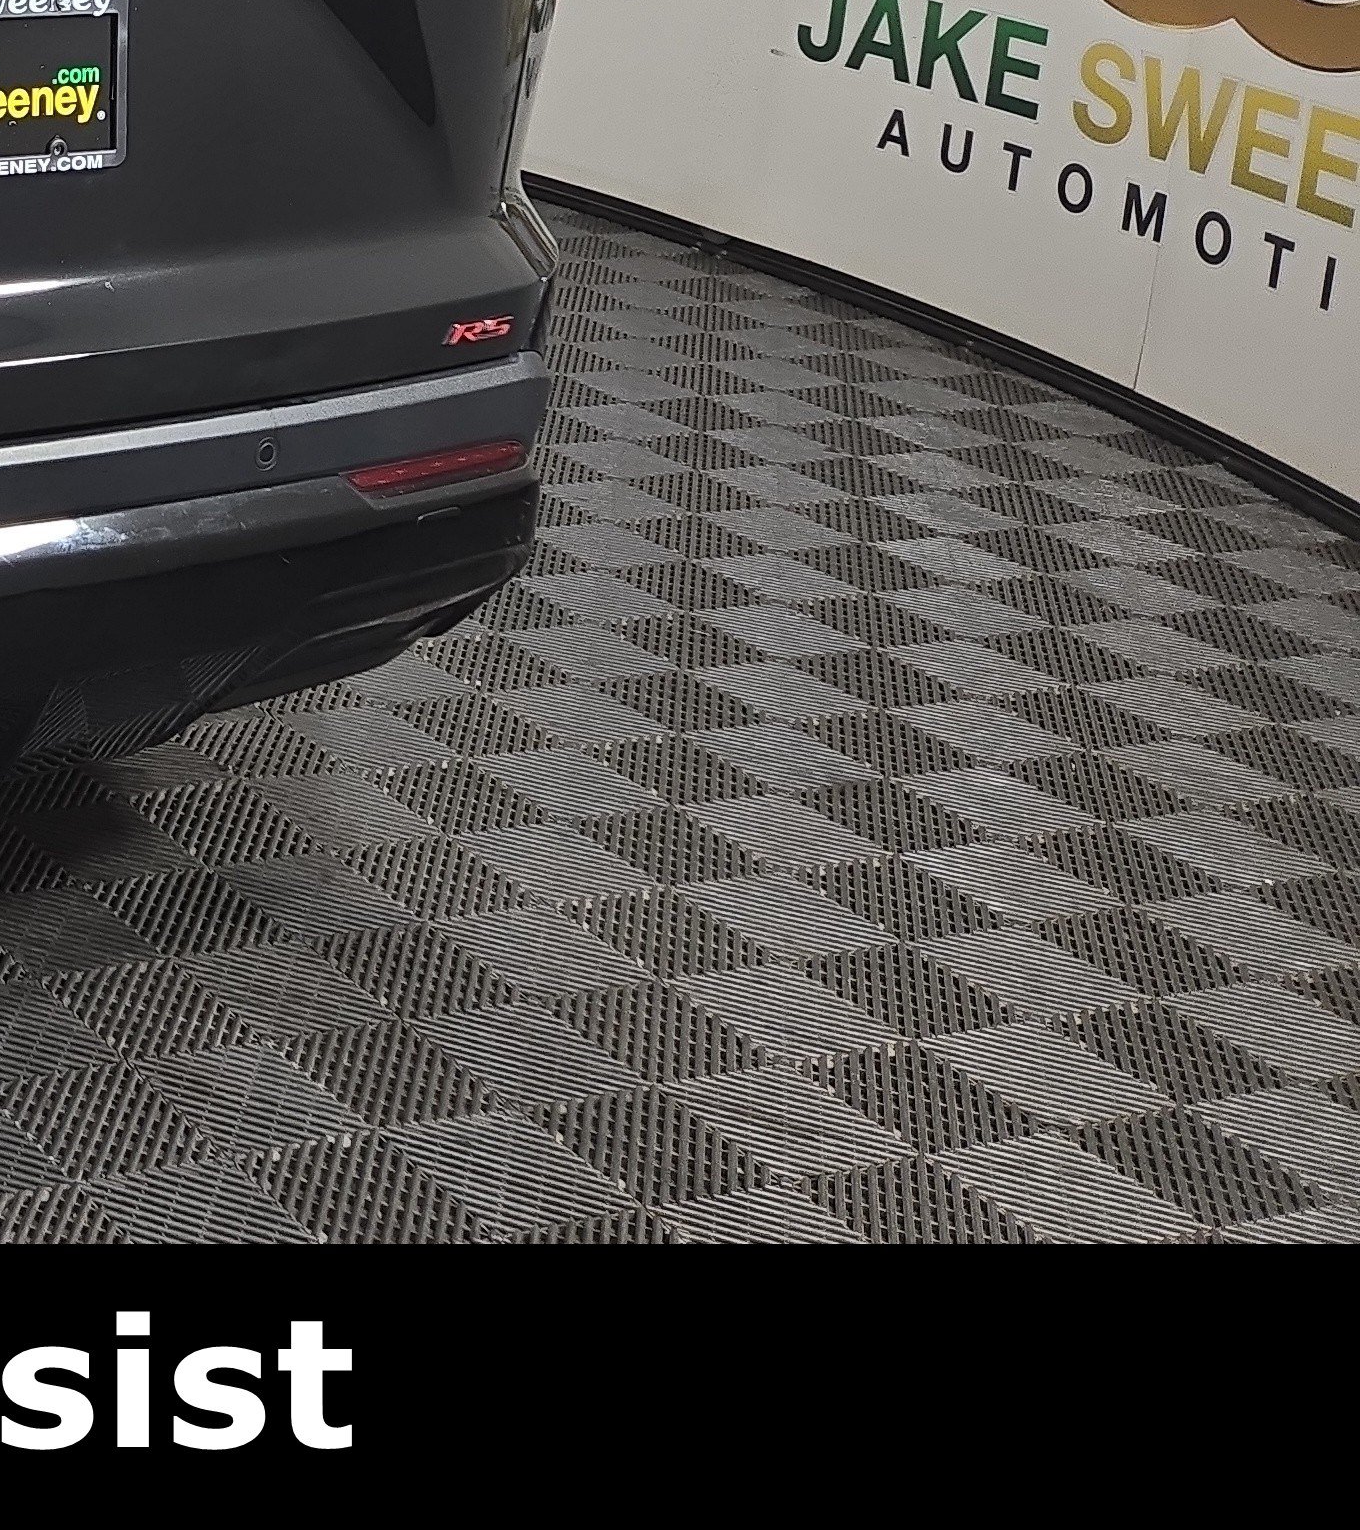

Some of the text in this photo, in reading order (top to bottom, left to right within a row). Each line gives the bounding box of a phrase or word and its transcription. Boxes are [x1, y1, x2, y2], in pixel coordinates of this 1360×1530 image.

[52, 67, 100, 85] .com
[1072, 40, 1360, 228] SWEE
[877, 109, 1337, 311] AUTOMOTI
[441, 315, 515, 346] RS
